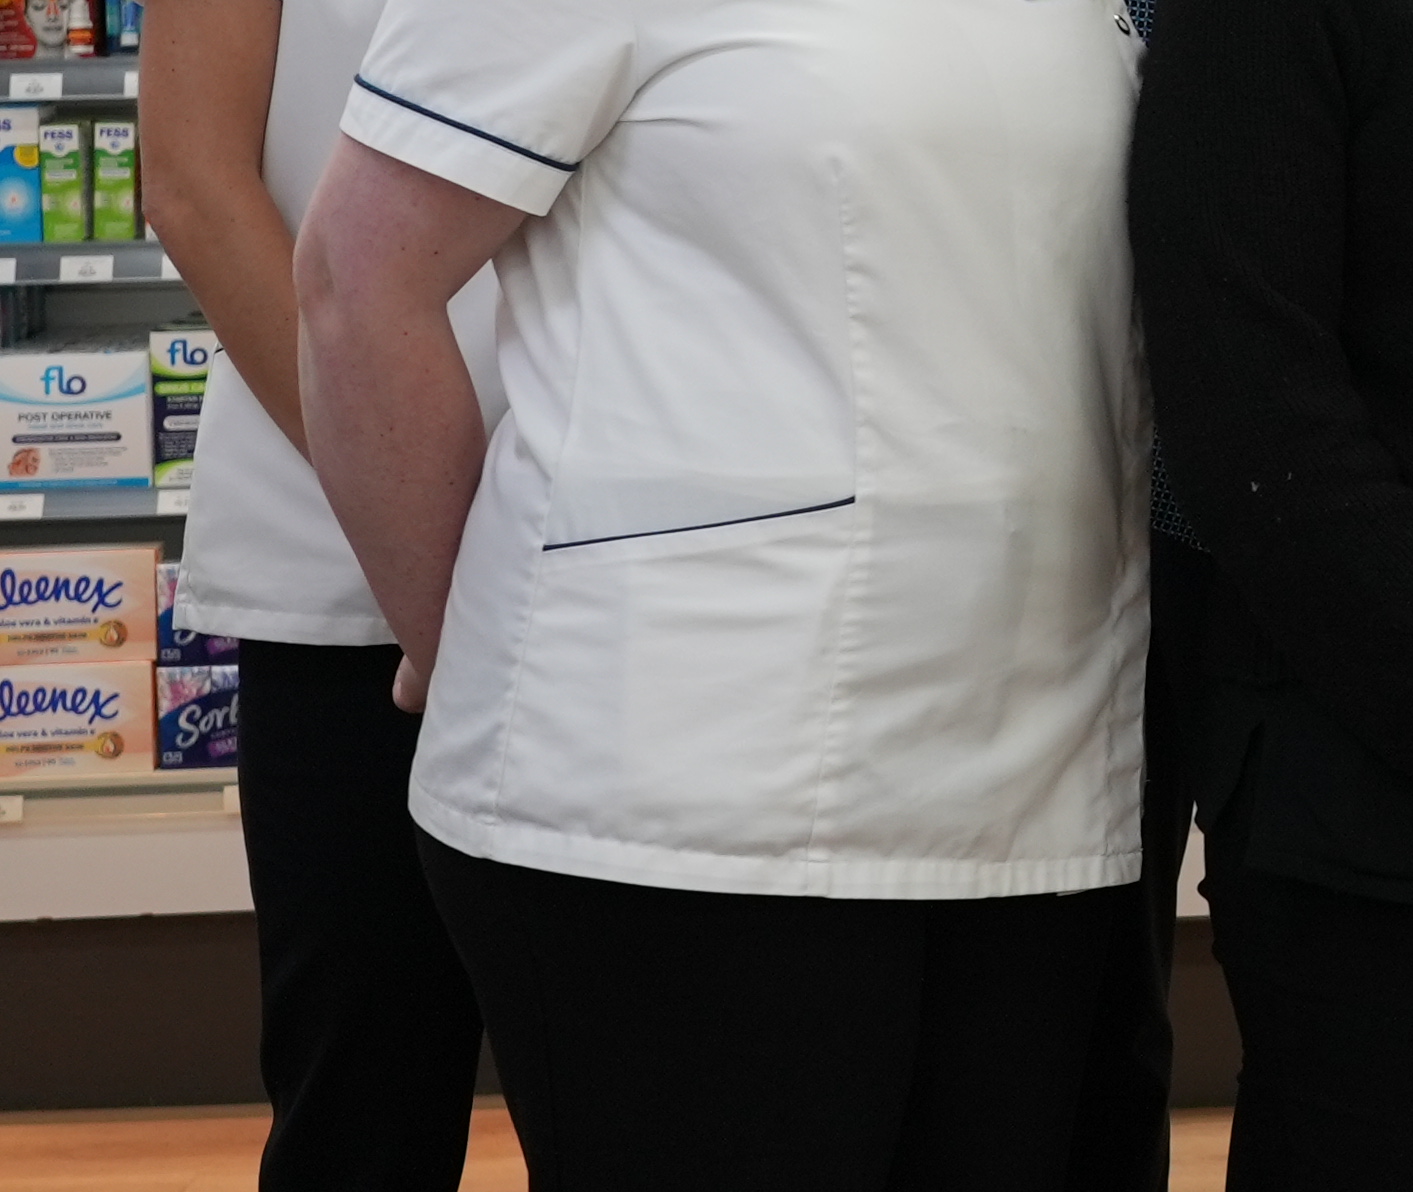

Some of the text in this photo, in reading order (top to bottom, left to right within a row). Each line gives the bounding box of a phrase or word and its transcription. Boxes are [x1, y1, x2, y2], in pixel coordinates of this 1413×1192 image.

[44, 129, 74, 140] FESS
[99, 127, 129, 138] FESS
[166, 338, 208, 367] flo
[40, 365, 87, 395] flo
[17, 410, 112, 422] POST OPERATIVE
[0, 568, 124, 613] leenex
[0, 679, 120, 725] leenex
